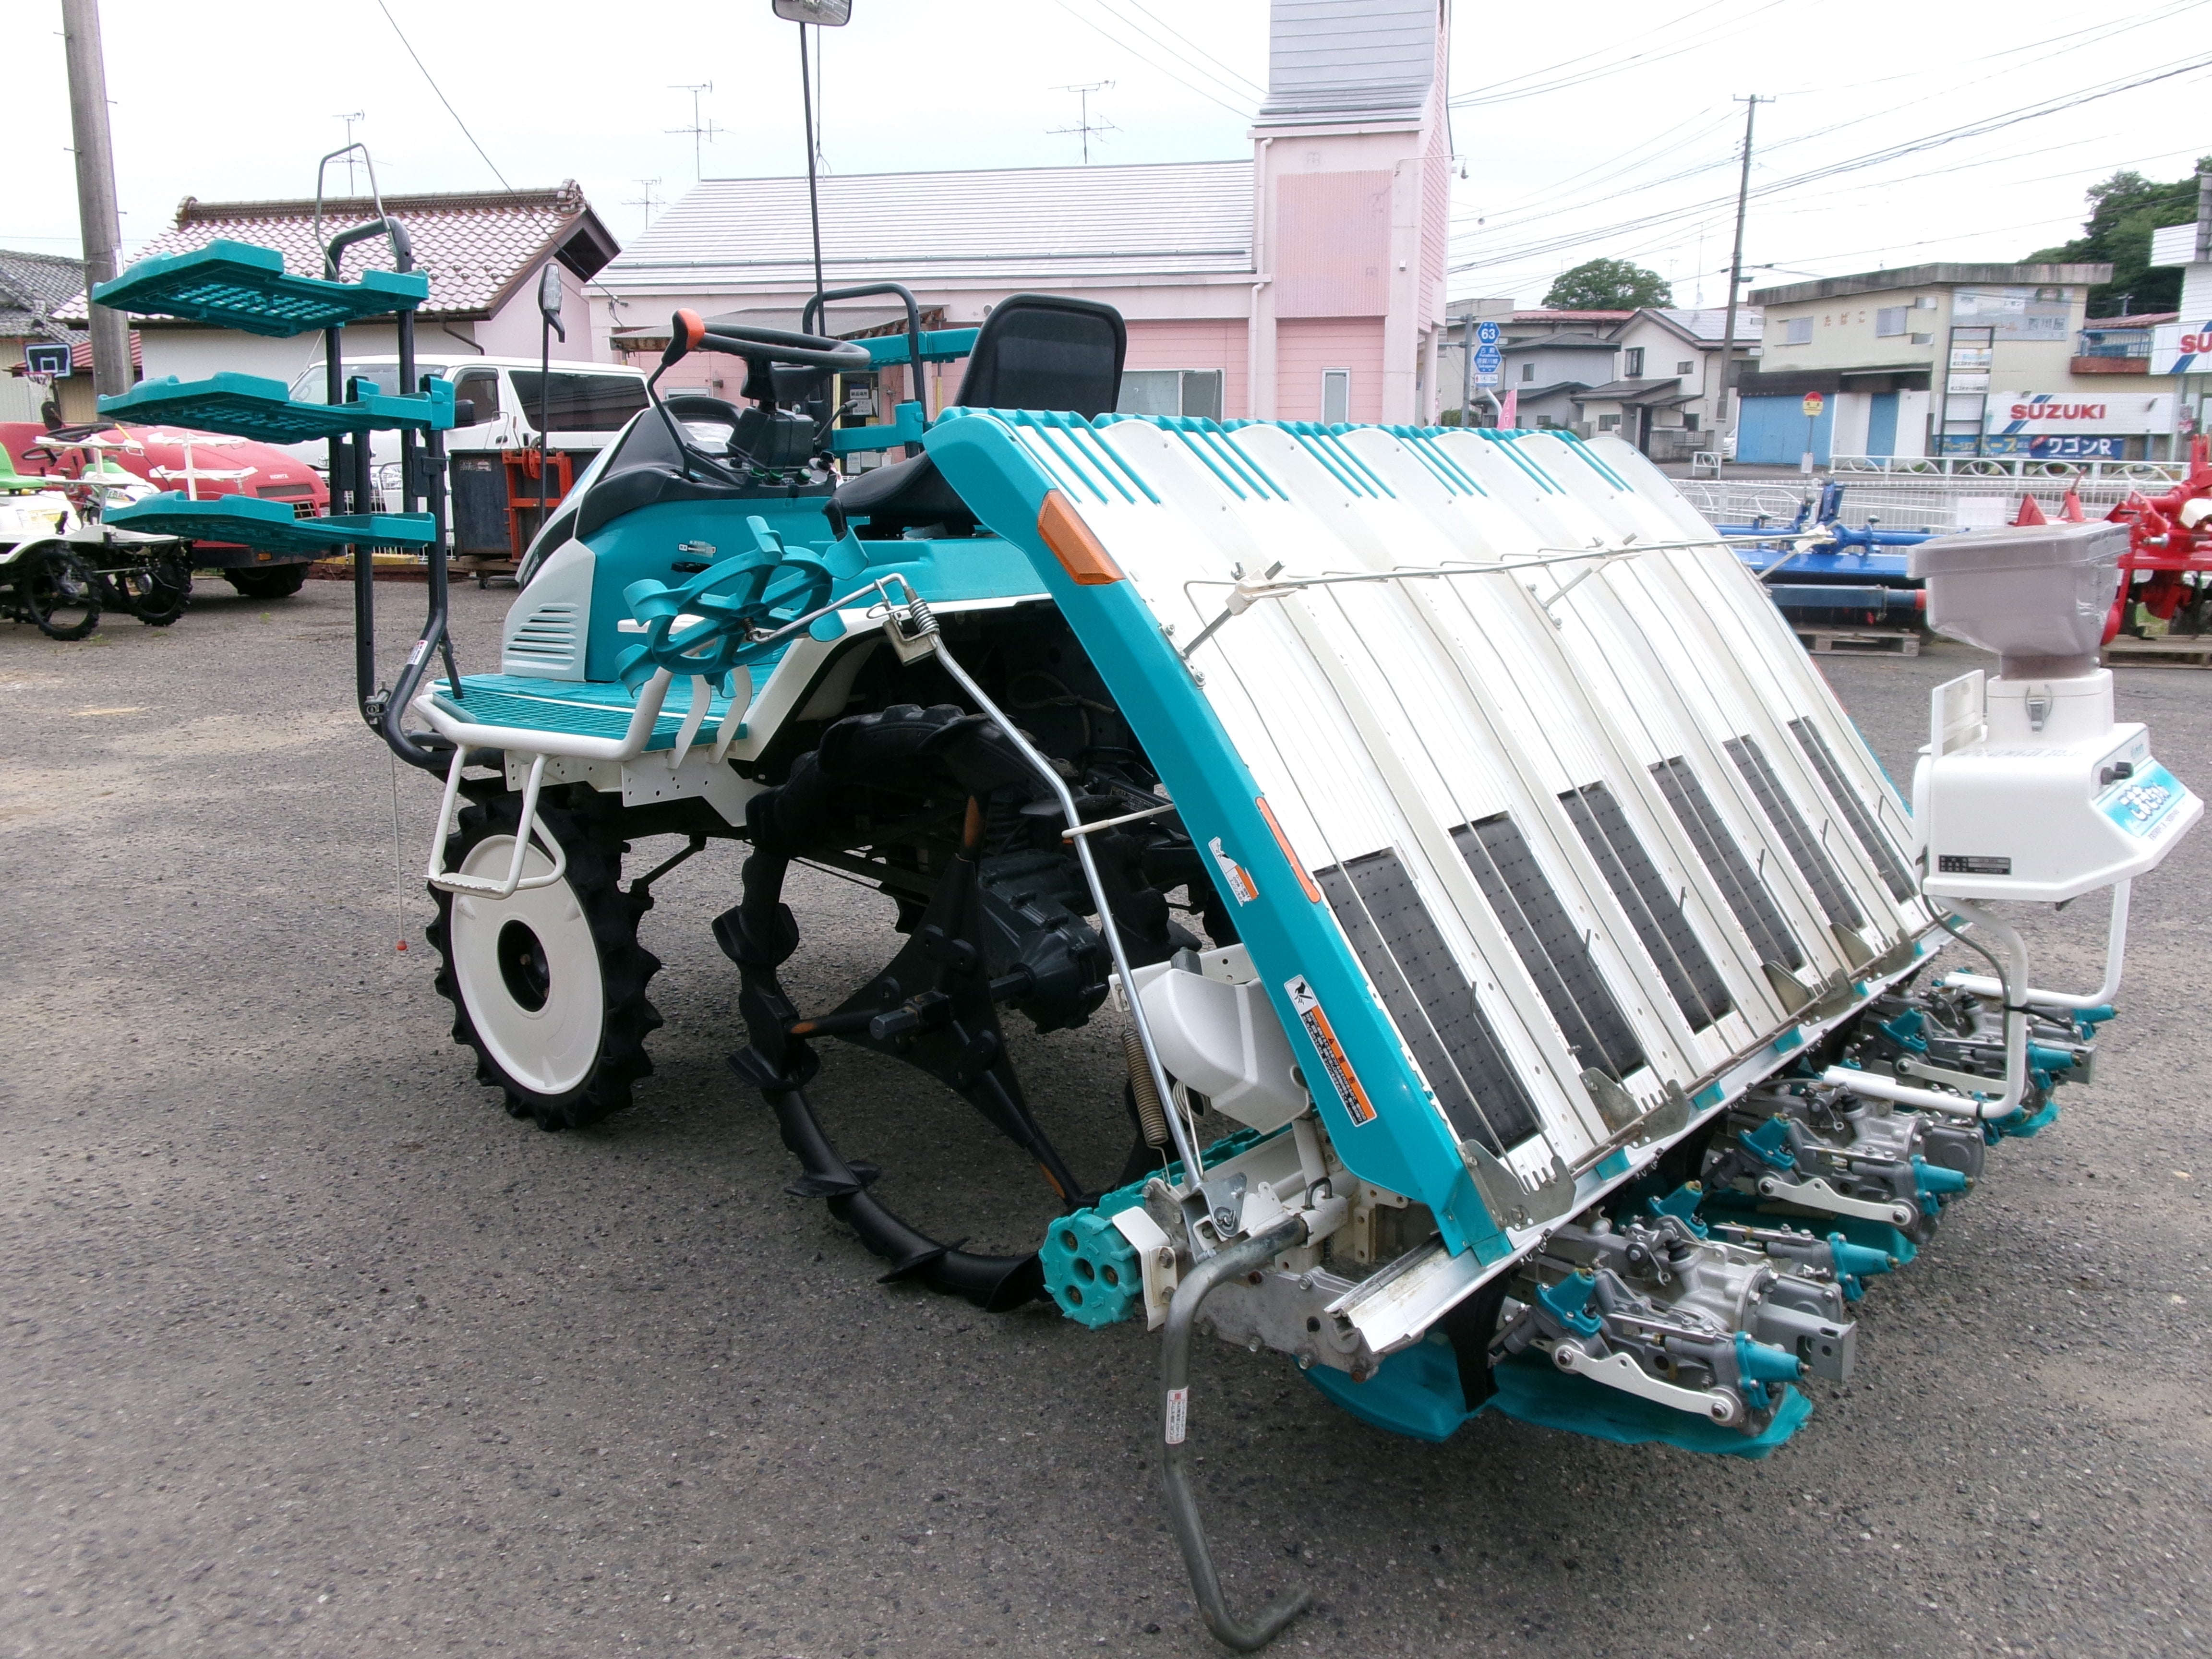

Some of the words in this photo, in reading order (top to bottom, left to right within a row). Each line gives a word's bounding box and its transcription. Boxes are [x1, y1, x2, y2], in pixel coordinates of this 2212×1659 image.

[1481, 328, 1495, 339] 63
[2010, 404, 2107, 419] SUZUKI
[2048, 437, 2112, 456] ワゴンR
